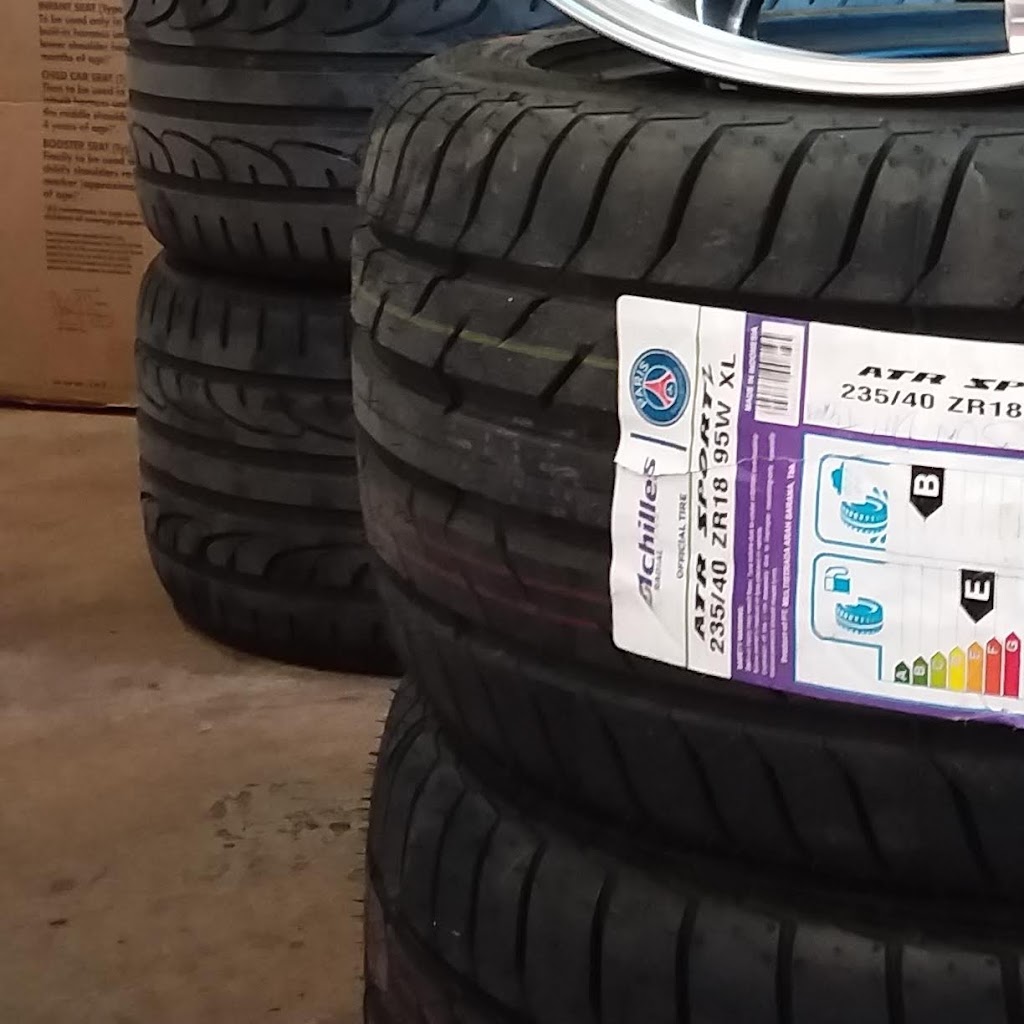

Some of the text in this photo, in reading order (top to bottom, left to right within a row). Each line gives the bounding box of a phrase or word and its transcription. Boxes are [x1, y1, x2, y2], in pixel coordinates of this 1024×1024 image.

[633, 360, 650, 409] PARIS
[858, 366, 946, 385] ATR
[841, 383, 935, 409] 235/40
[947, 396, 1022, 418] ZR18
[710, 354, 736, 655] 235/40 ZR18 95W XL
[913, 473, 940, 497] B
[637, 457, 657, 610] Achilles
[676, 493, 687, 579] OFFICIAL TIRE
[695, 553, 706, 641] ATR
[964, 579, 990, 602] E
[1006, 640, 1018, 652] G
